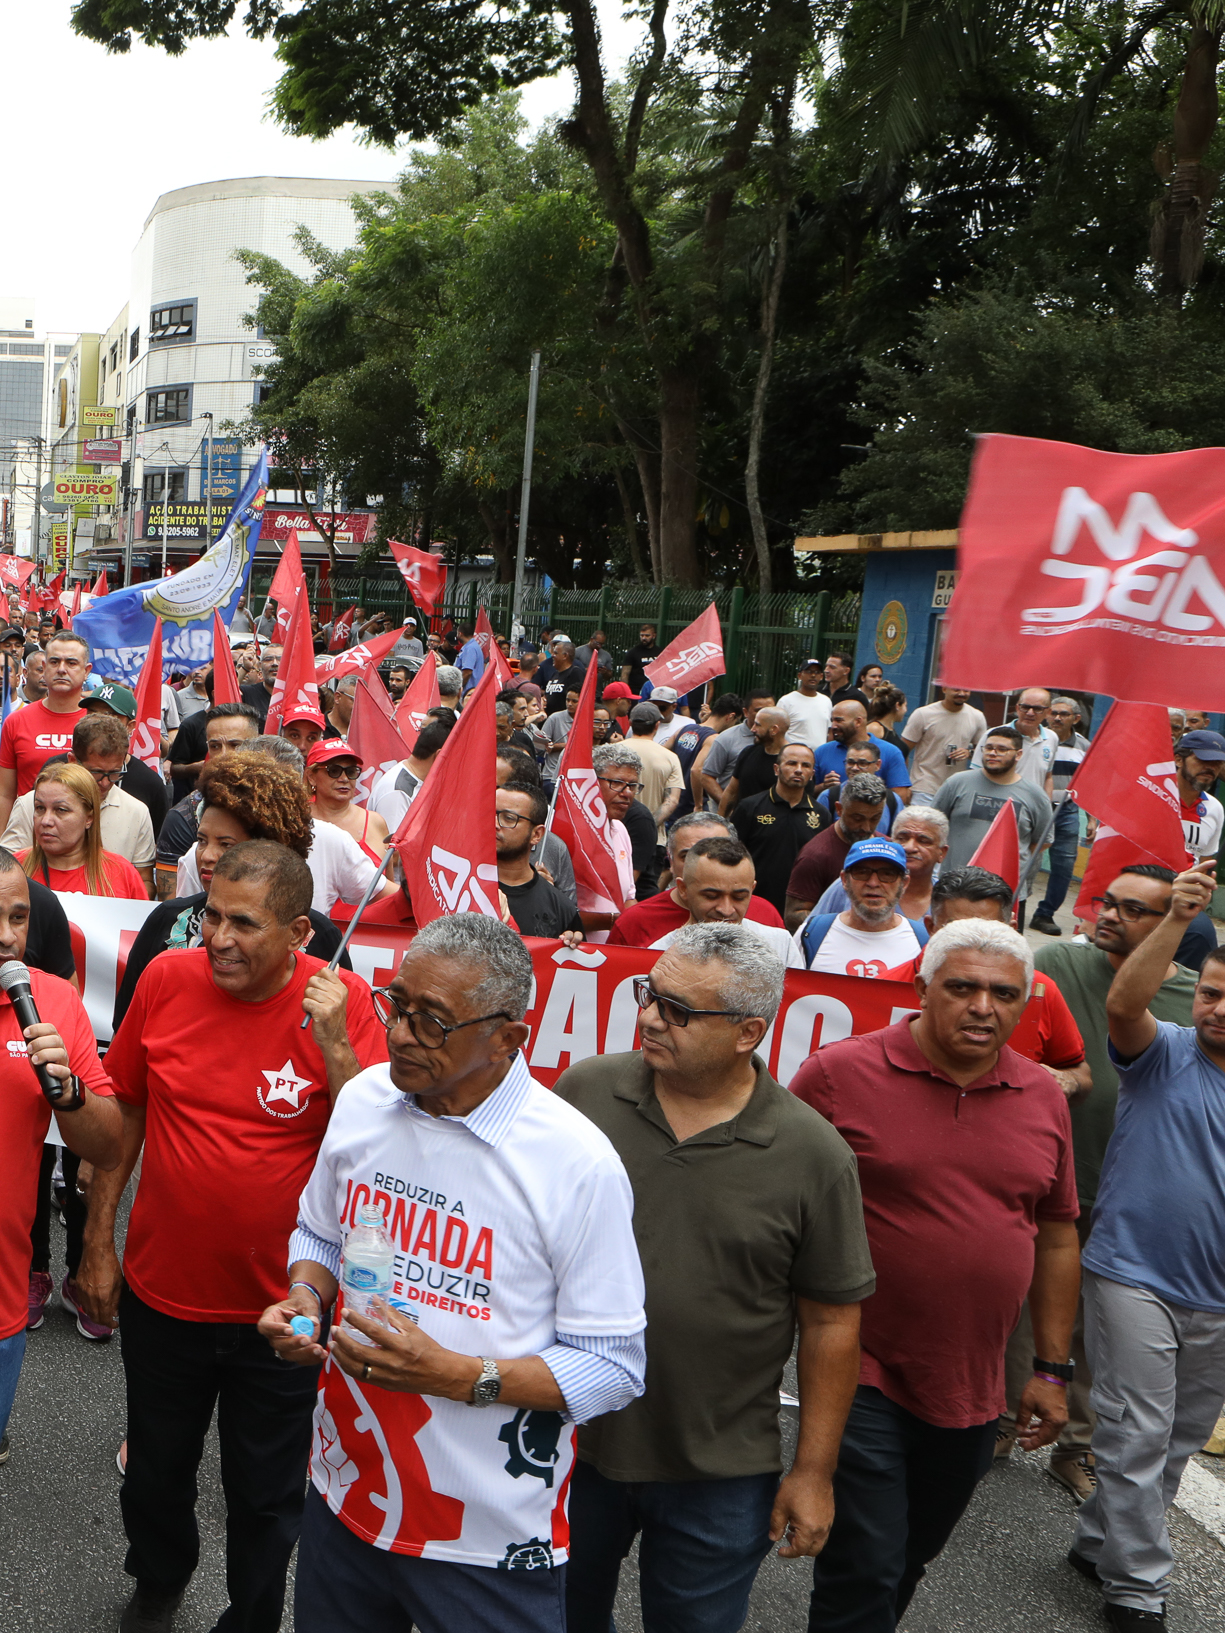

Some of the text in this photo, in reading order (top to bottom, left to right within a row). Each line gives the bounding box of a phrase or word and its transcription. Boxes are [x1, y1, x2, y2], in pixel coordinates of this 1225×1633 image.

[204, 444, 237, 455] AVOGADO
[56, 483, 113, 495] OURO
[189, 516, 196, 525] DO
[275, 515, 311, 529] Bella
[1136, 776, 1179, 812] SINDICATO
[852, 964, 879, 978] 13
[6, 1040, 28, 1052] CU
[275, 1078, 298, 1092] PT
[256, 1086, 267, 1109] PARTIDO
[265, 1107, 277, 1117] DOS
[374, 1172, 465, 1216] REDUZIR A
[340, 1179, 493, 1281] JORNADA
[393, 1254, 490, 1303] EDUZIR
[393, 1281, 491, 1321] E DIREITOS
